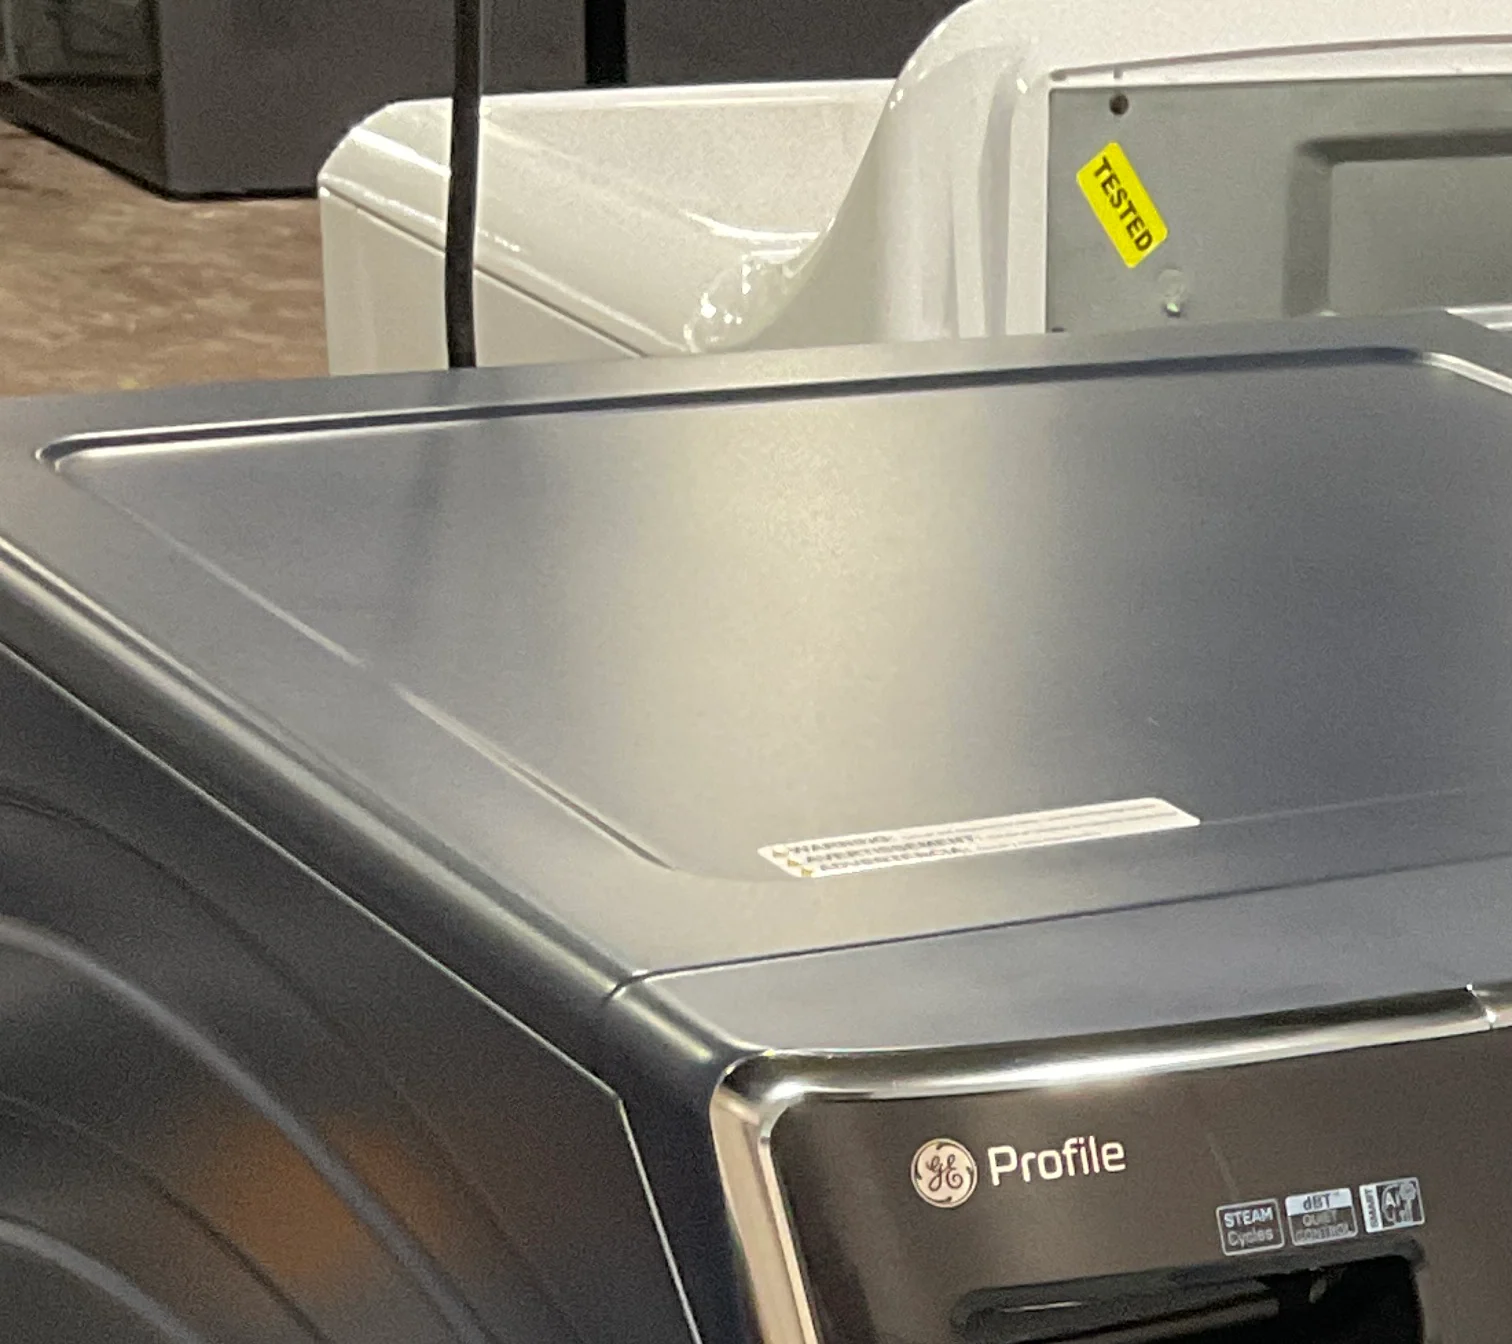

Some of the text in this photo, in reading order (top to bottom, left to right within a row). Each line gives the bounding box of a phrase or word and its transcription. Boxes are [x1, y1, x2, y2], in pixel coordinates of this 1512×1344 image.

[1093, 156, 1153, 252] TESTED
[987, 1135, 1126, 1186] Profile
[1224, 1207, 1273, 1228] STEAM
[1227, 1227, 1274, 1247] Cycles
